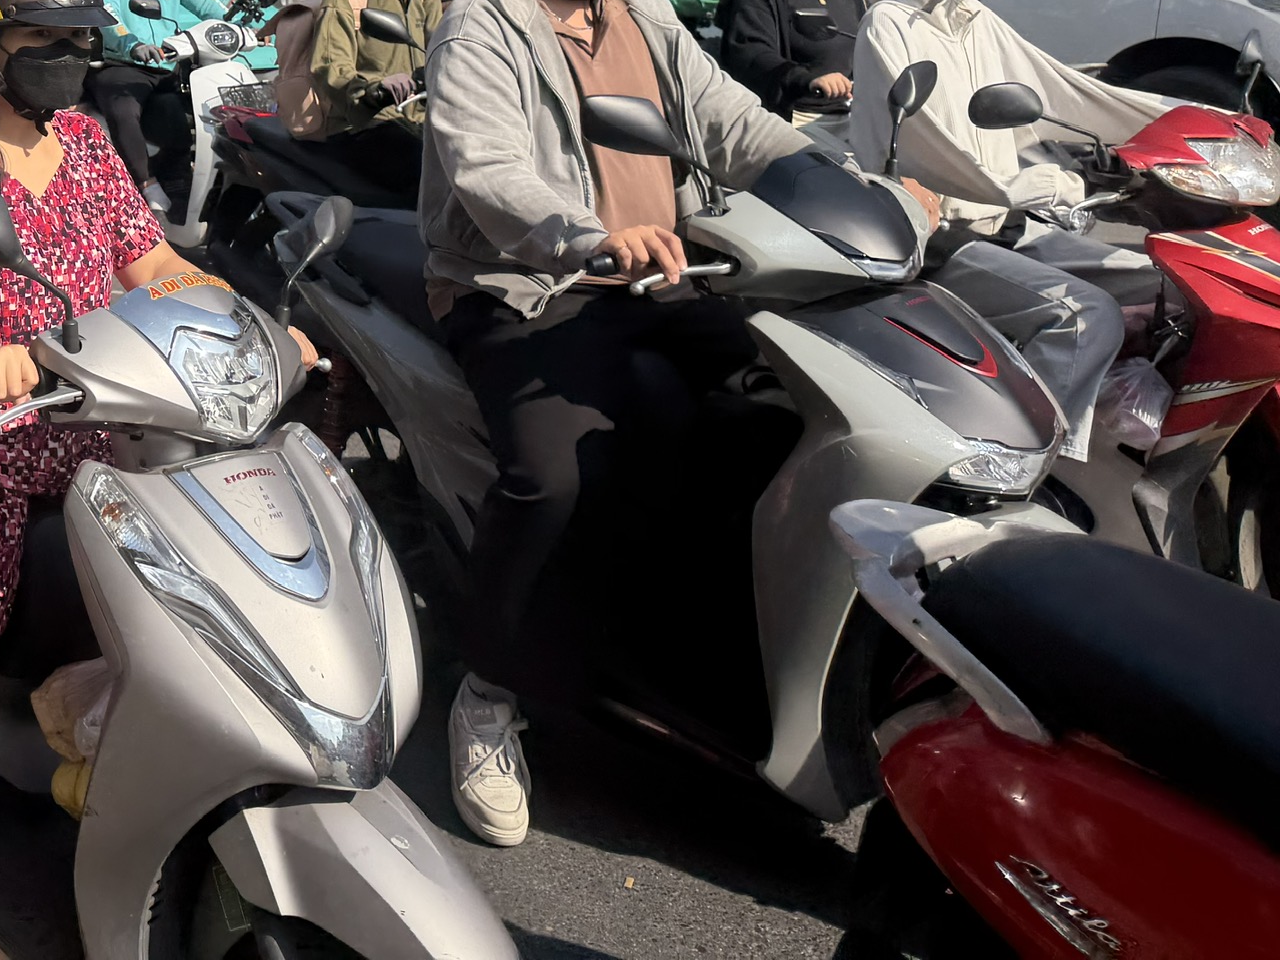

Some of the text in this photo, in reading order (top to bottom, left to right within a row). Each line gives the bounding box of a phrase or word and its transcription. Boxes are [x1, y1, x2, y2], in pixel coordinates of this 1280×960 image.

[147, 285, 165, 300] A
[159, 278, 183, 294] DI
[178, 271, 205, 288] ĐÀ
[223, 468, 276, 485] HONDA
